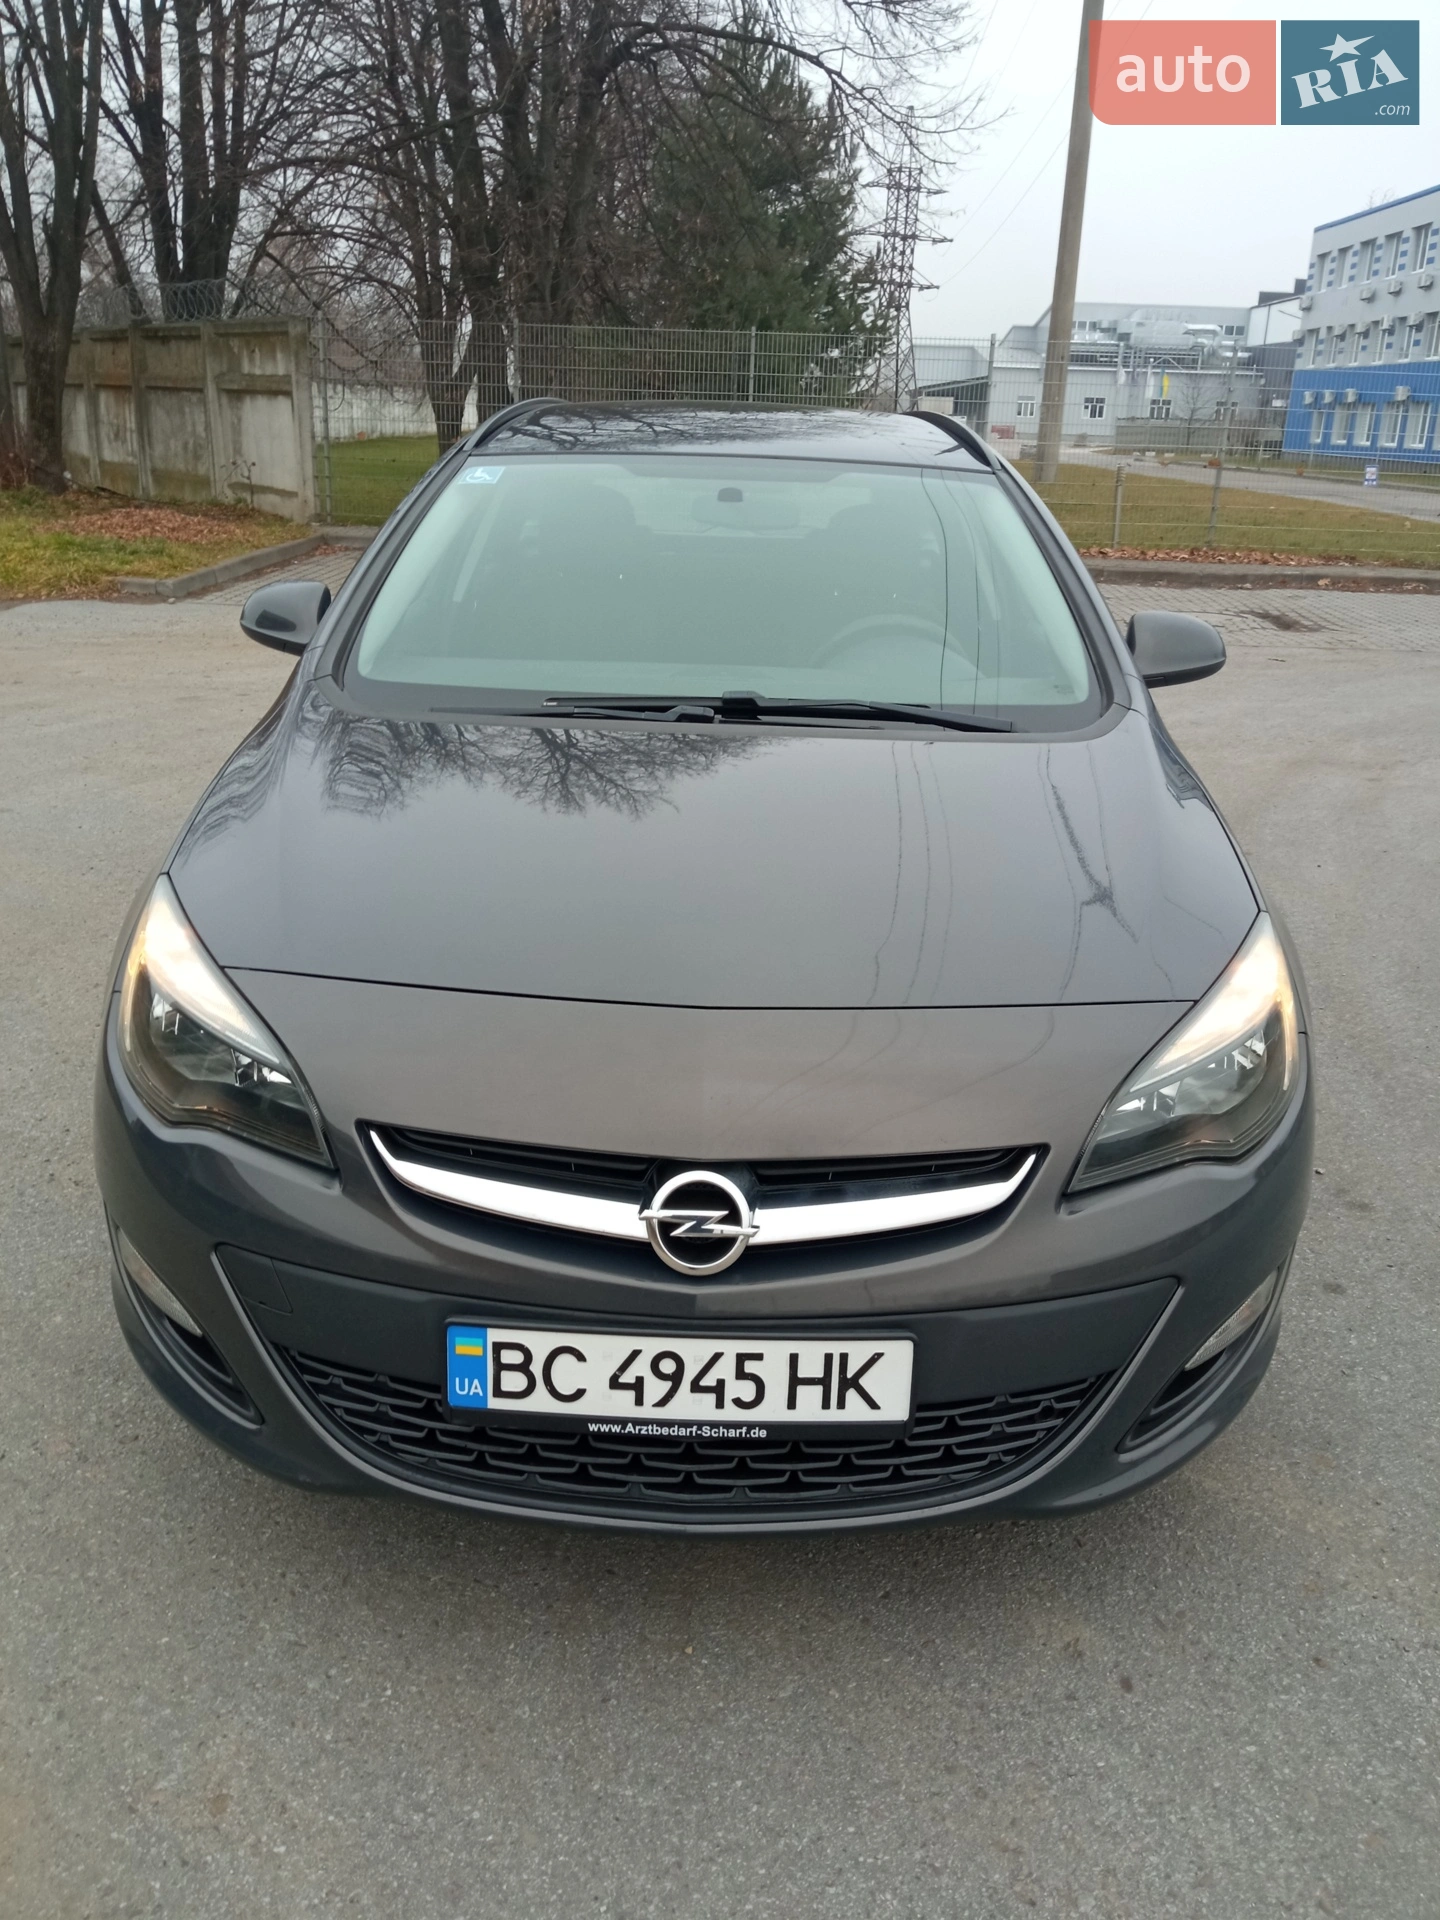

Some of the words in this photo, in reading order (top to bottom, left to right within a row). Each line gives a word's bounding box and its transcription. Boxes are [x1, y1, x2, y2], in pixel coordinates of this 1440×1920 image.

[491, 1341, 587, 1403] BC
[608, 1349, 766, 1410] 4945
[786, 1352, 885, 1410] HK
[455, 1377, 484, 1396] UA
[587, 1422, 768, 1438] www.Arztbedarf-Scharf.de
